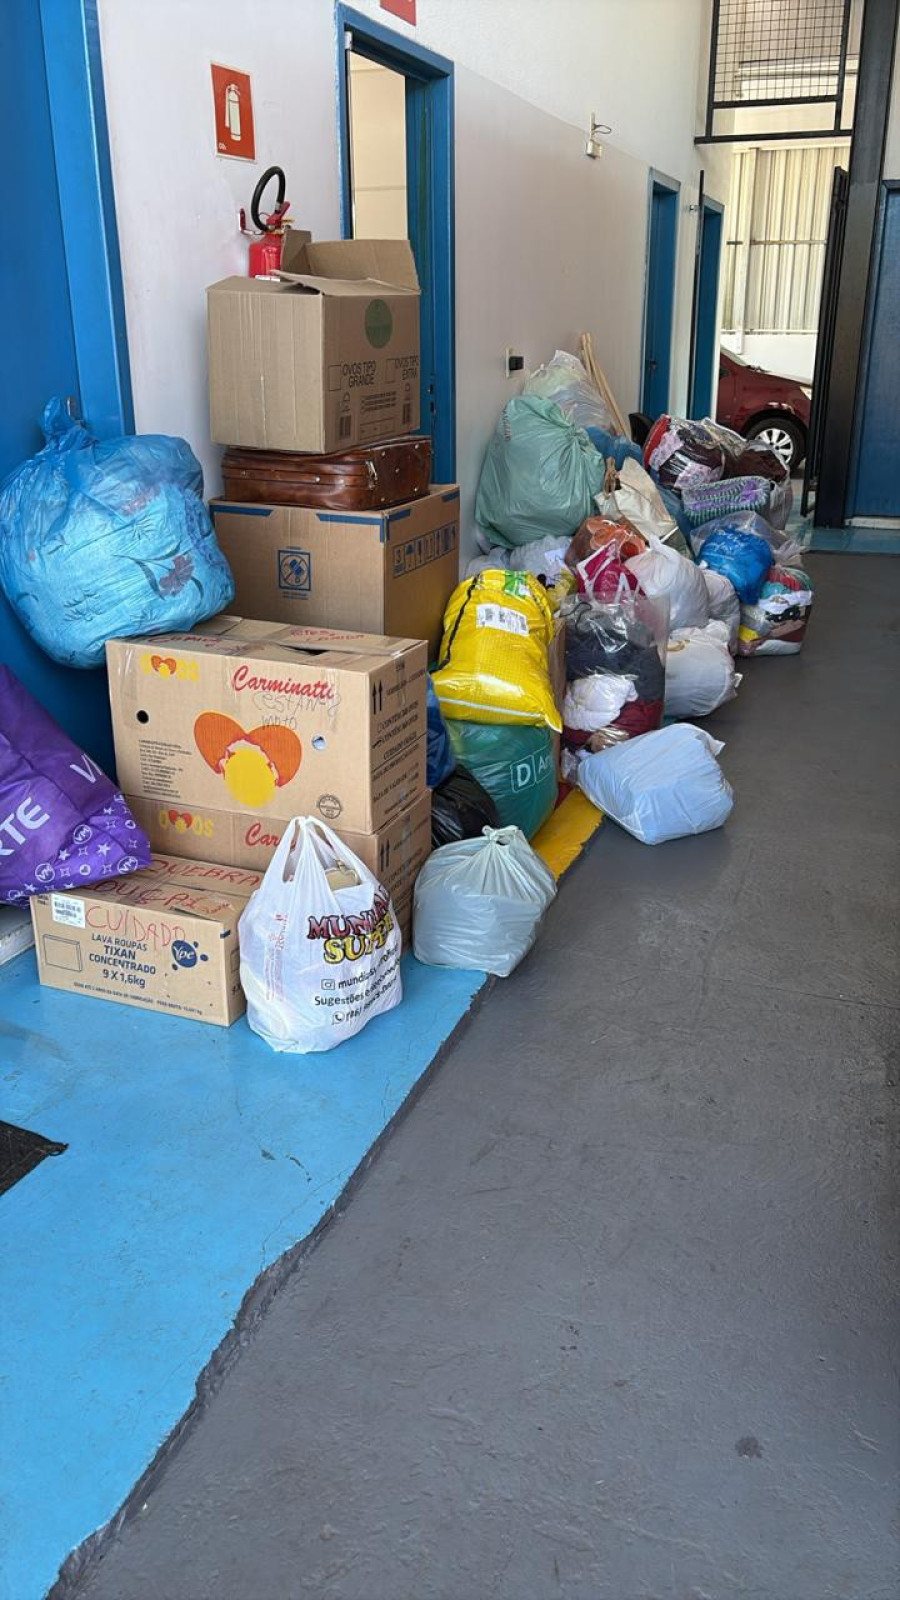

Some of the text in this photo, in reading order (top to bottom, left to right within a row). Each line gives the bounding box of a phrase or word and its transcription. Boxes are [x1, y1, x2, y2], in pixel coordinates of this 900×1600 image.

[232, 665, 335, 700] Carminatti
[85, 905, 187, 950] CUIDADO
[91, 932, 148, 952] LAVA ROUPAS
[104, 944, 136, 961] TIXAN
[89, 953, 156, 976] CONCENTRADO
[102, 968, 110, 979] 9
[110, 970, 120, 982] X
